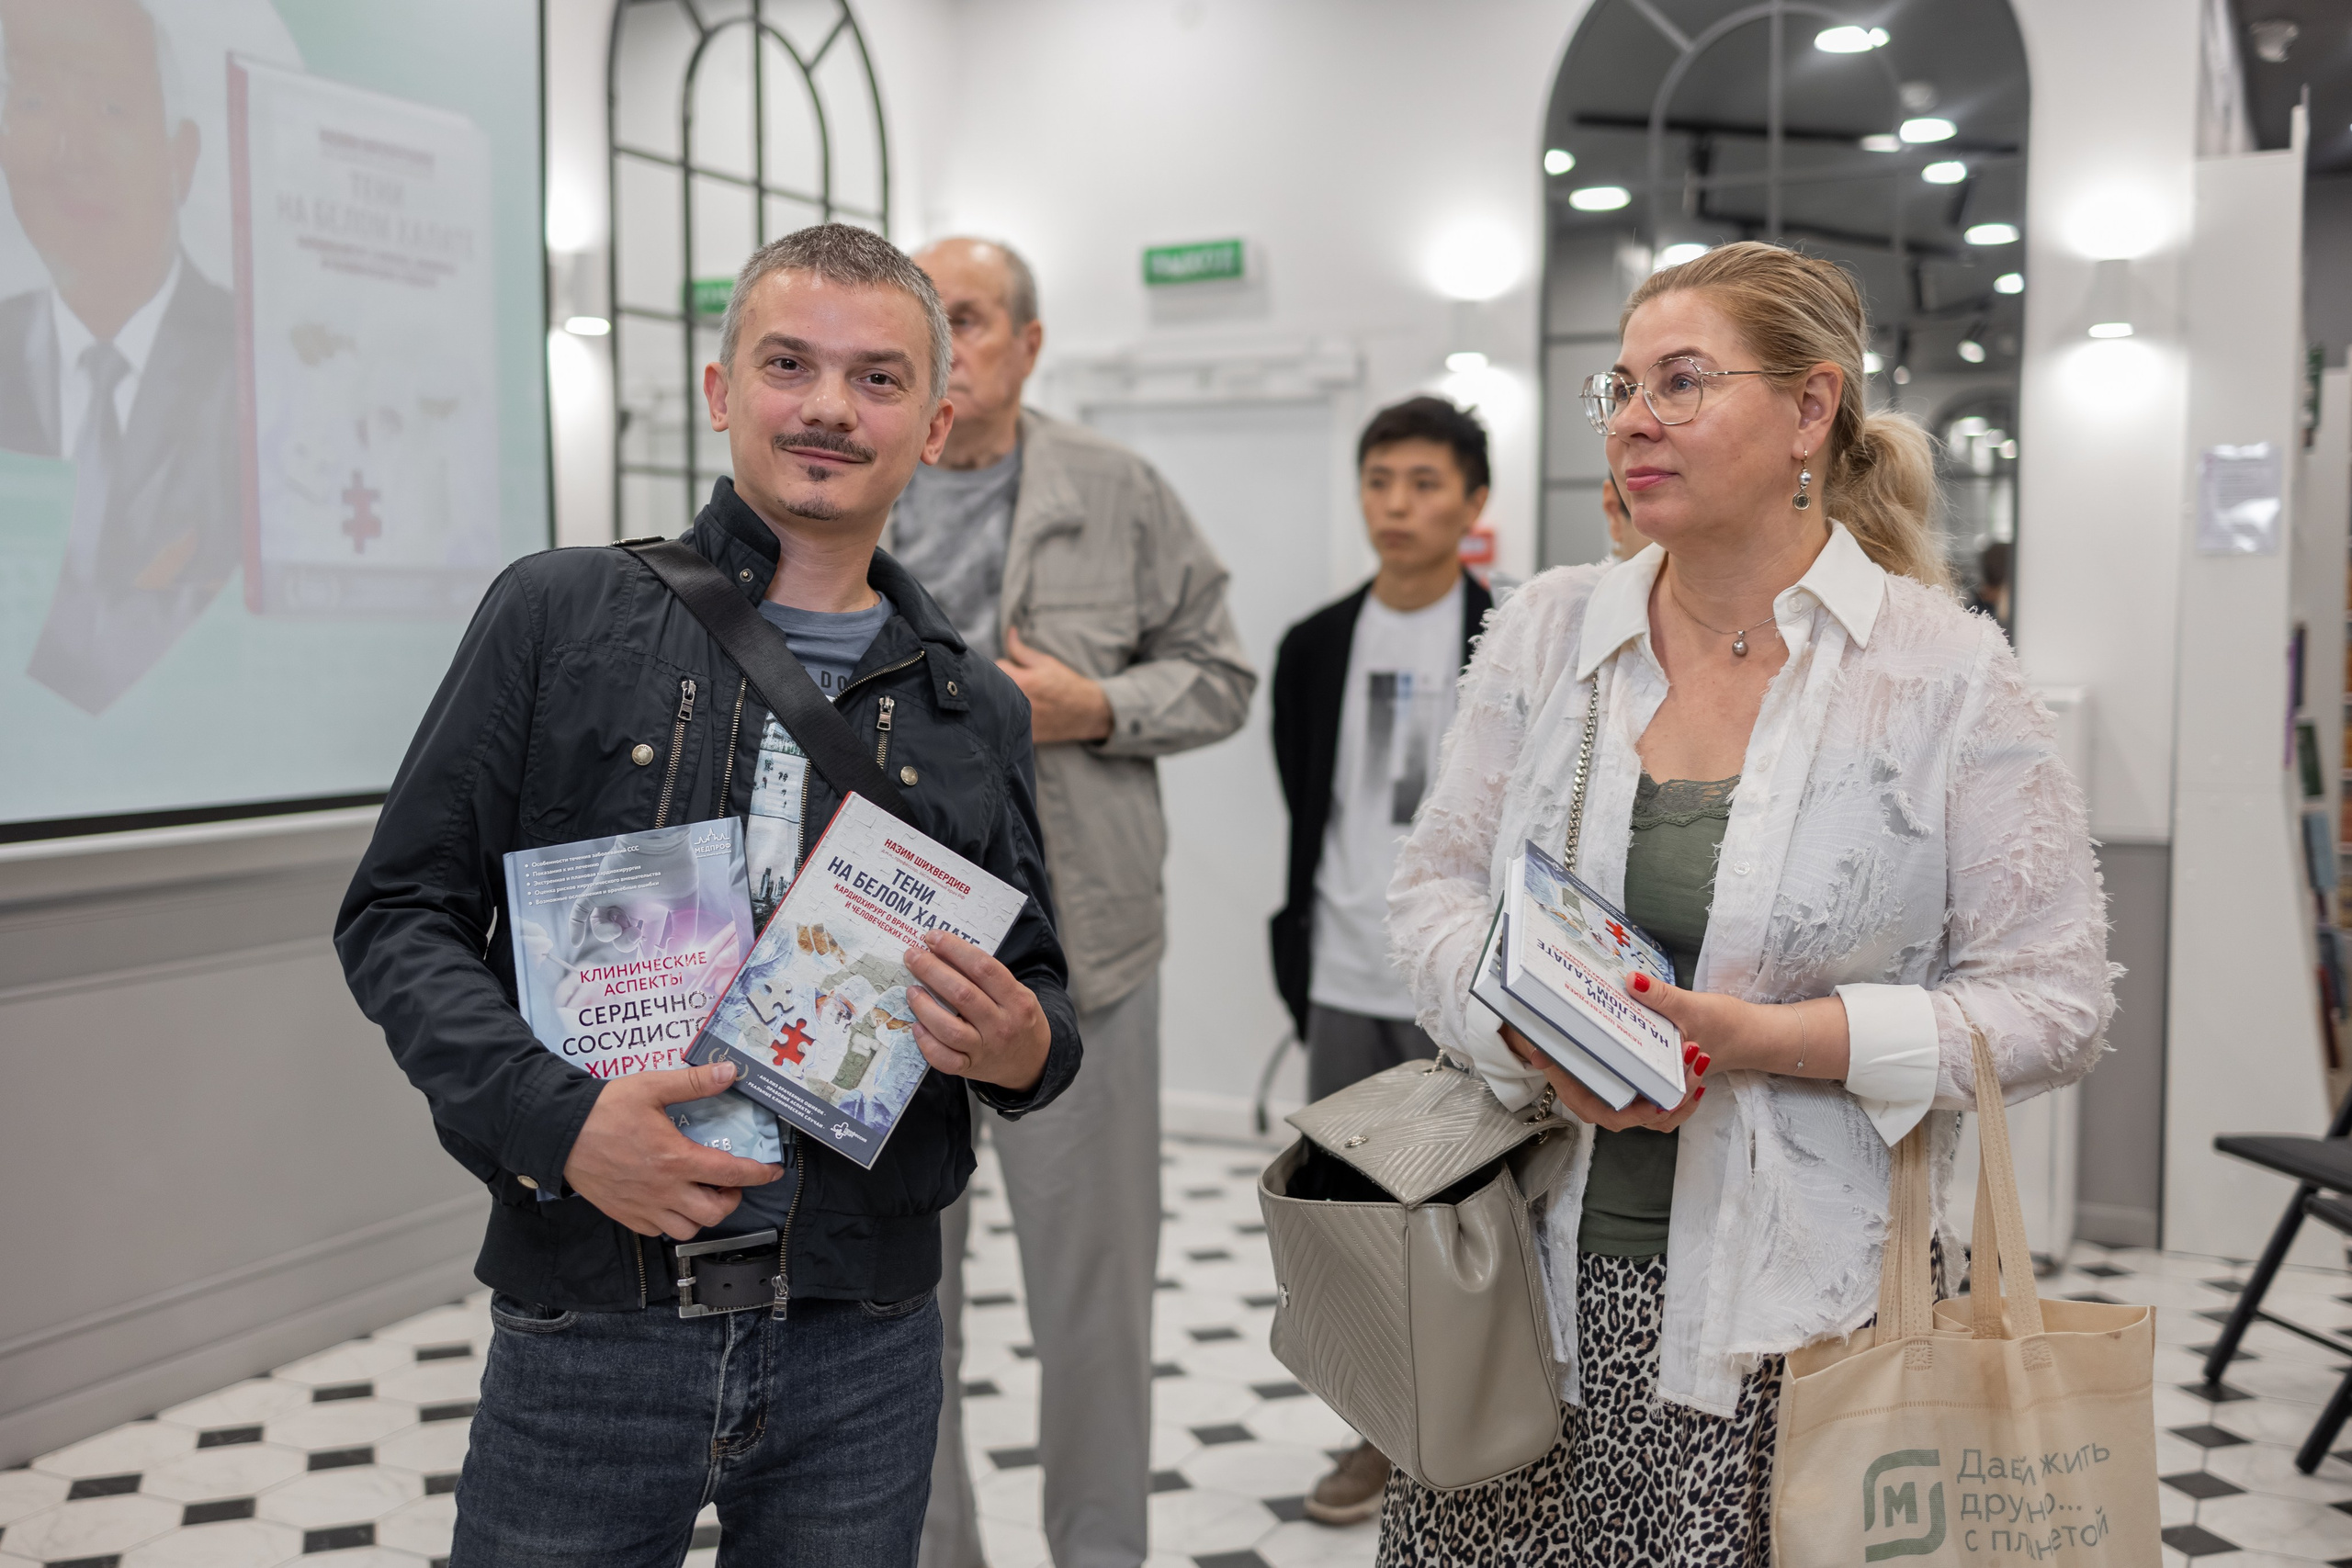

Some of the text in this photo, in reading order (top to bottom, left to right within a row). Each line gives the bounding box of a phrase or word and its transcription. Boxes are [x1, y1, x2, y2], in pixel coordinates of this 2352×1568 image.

[532, 857, 568, 868] Особенности
[569, 854, 592, 863] течения
[695, 842, 731, 853] МЕДПРОФ
[533, 868, 562, 877] Показания
[575, 863, 600, 871] лечению
[884, 838, 971, 895] НАЗИМ ШИХВЕРДИЕВ
[827, 855, 853, 882] НА
[853, 871, 914, 917] БЕЛОМ
[892, 868, 936, 906] ТЕНИ
[833, 883, 888, 919] КАРДИОХИРУРГ
[890, 917, 919, 940] ВРАЧАХ,
[844, 900, 851, 908] И
[851, 904, 901, 940] ЧЕЛОВЕЧЕСКИХ
[580, 951, 707, 984] КЛИНИЧЕСКИЕ
[604, 972, 684, 997] АСПЕКТЫ
[578, 989, 716, 1027] СЕРДЕЧНО-
[1537, 939, 1668, 1048] НА БЕЛОМ ХАЛАТЕ
[1587, 987, 1623, 1022] ТЕНИ
[748, 1081, 773, 1099] РЕАЛЬНЫЕ
[759, 1075, 778, 1089] АНАЛИЗ
[804, 1100, 824, 1115] ОШИБОК
[789, 1099, 812, 1114] АСПЕКТЫ
[2040, 1443, 2110, 1478] жить
[1965, 1529, 1978, 1551] с
